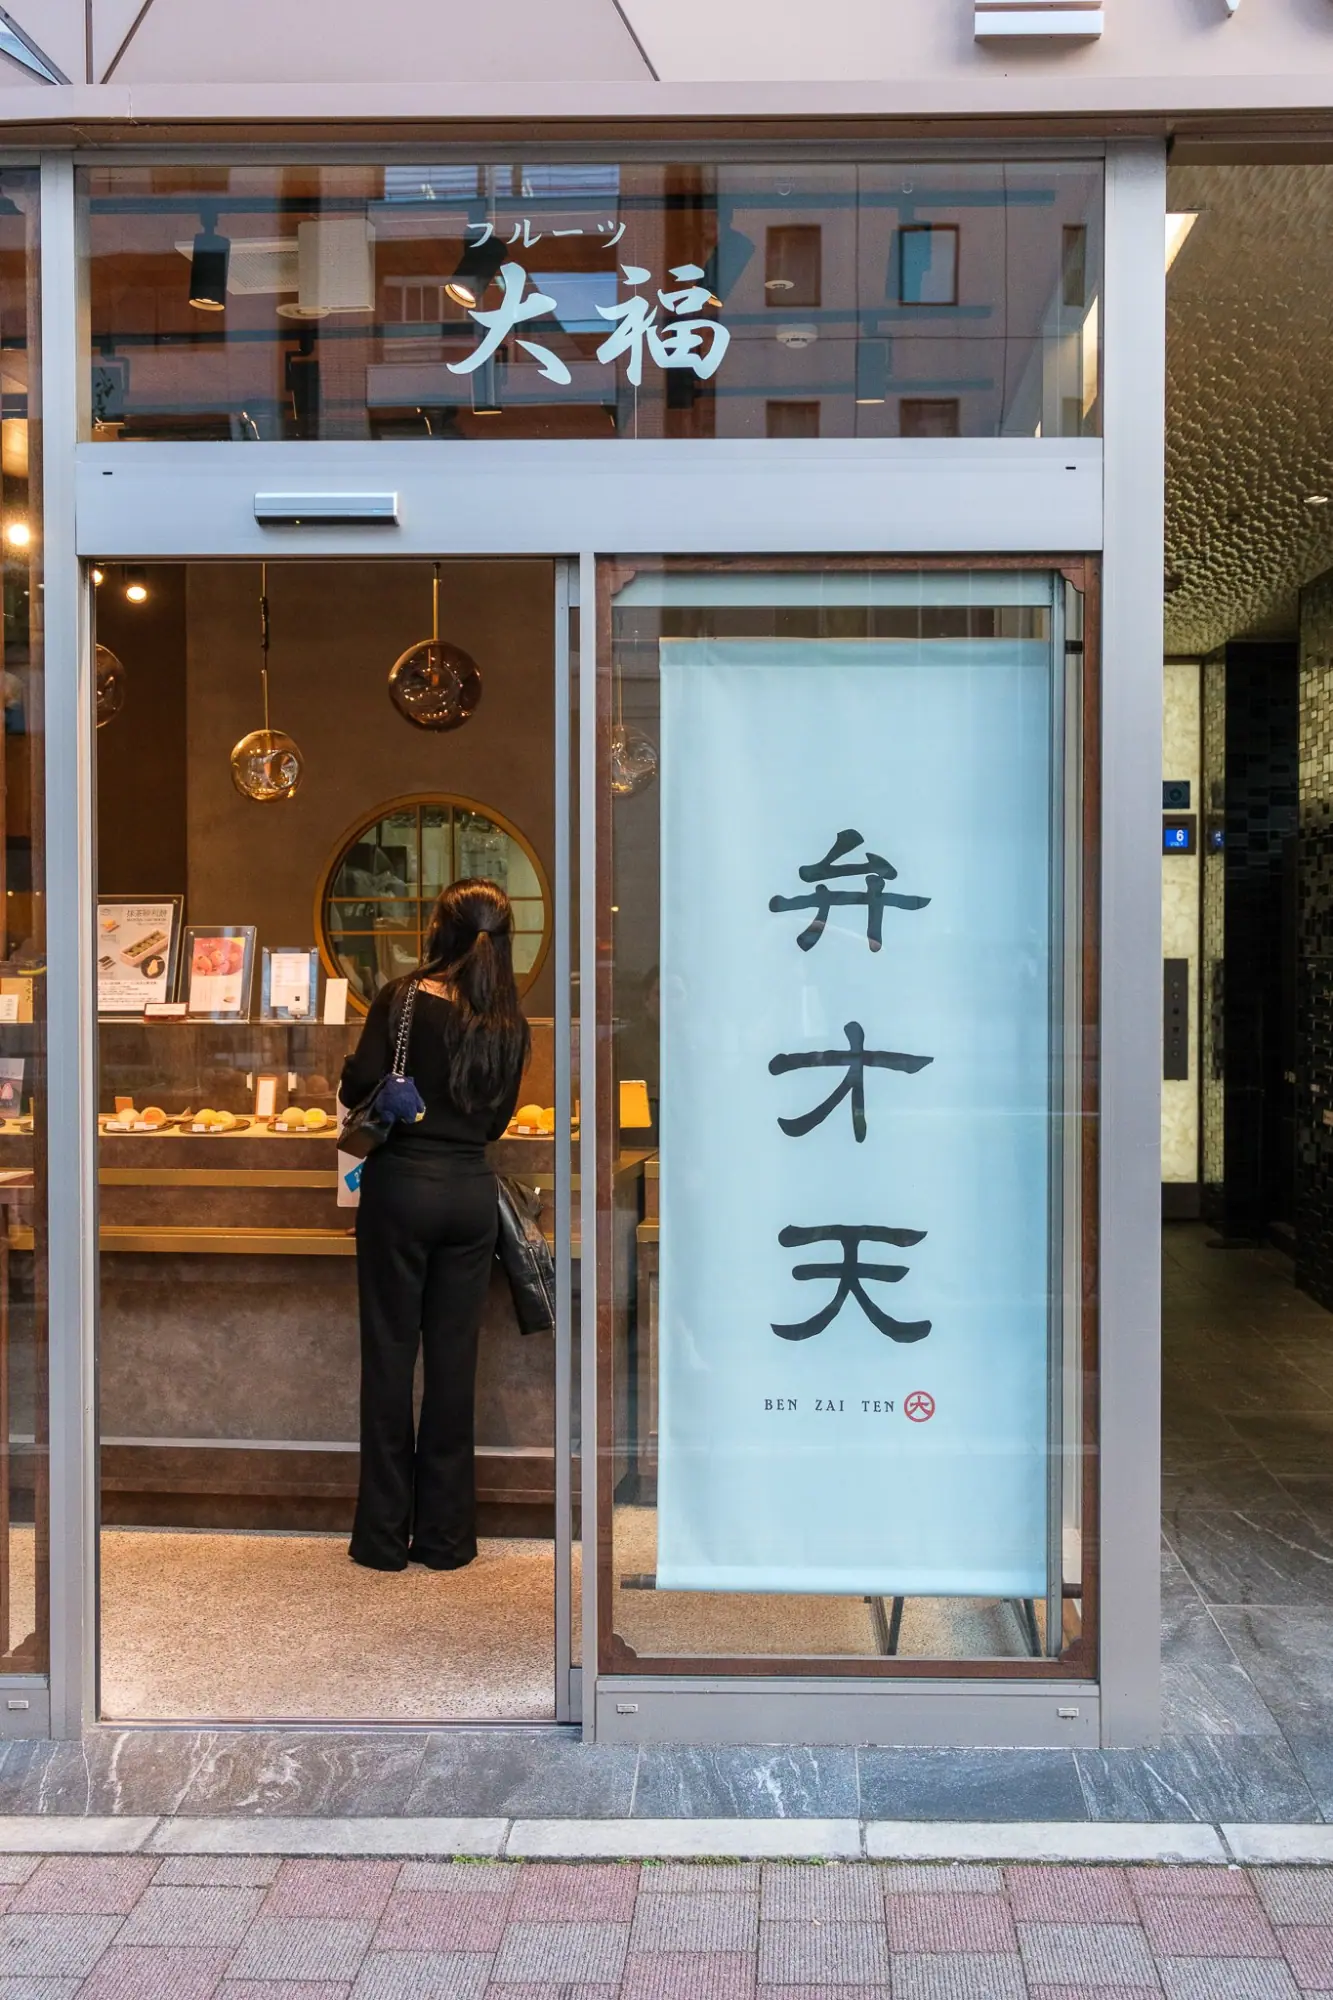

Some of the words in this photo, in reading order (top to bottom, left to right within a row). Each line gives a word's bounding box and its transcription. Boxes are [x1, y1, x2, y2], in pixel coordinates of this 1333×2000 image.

[466, 219, 626, 248] フルーツ
[446, 262, 731, 387] 大福
[1176, 829, 1185, 842] 6
[768, 828, 935, 1344] 弁才天
[764, 1399, 798, 1411] BEN
[815, 1400, 845, 1412] ZAI
[861, 1401, 895, 1413] TEN
